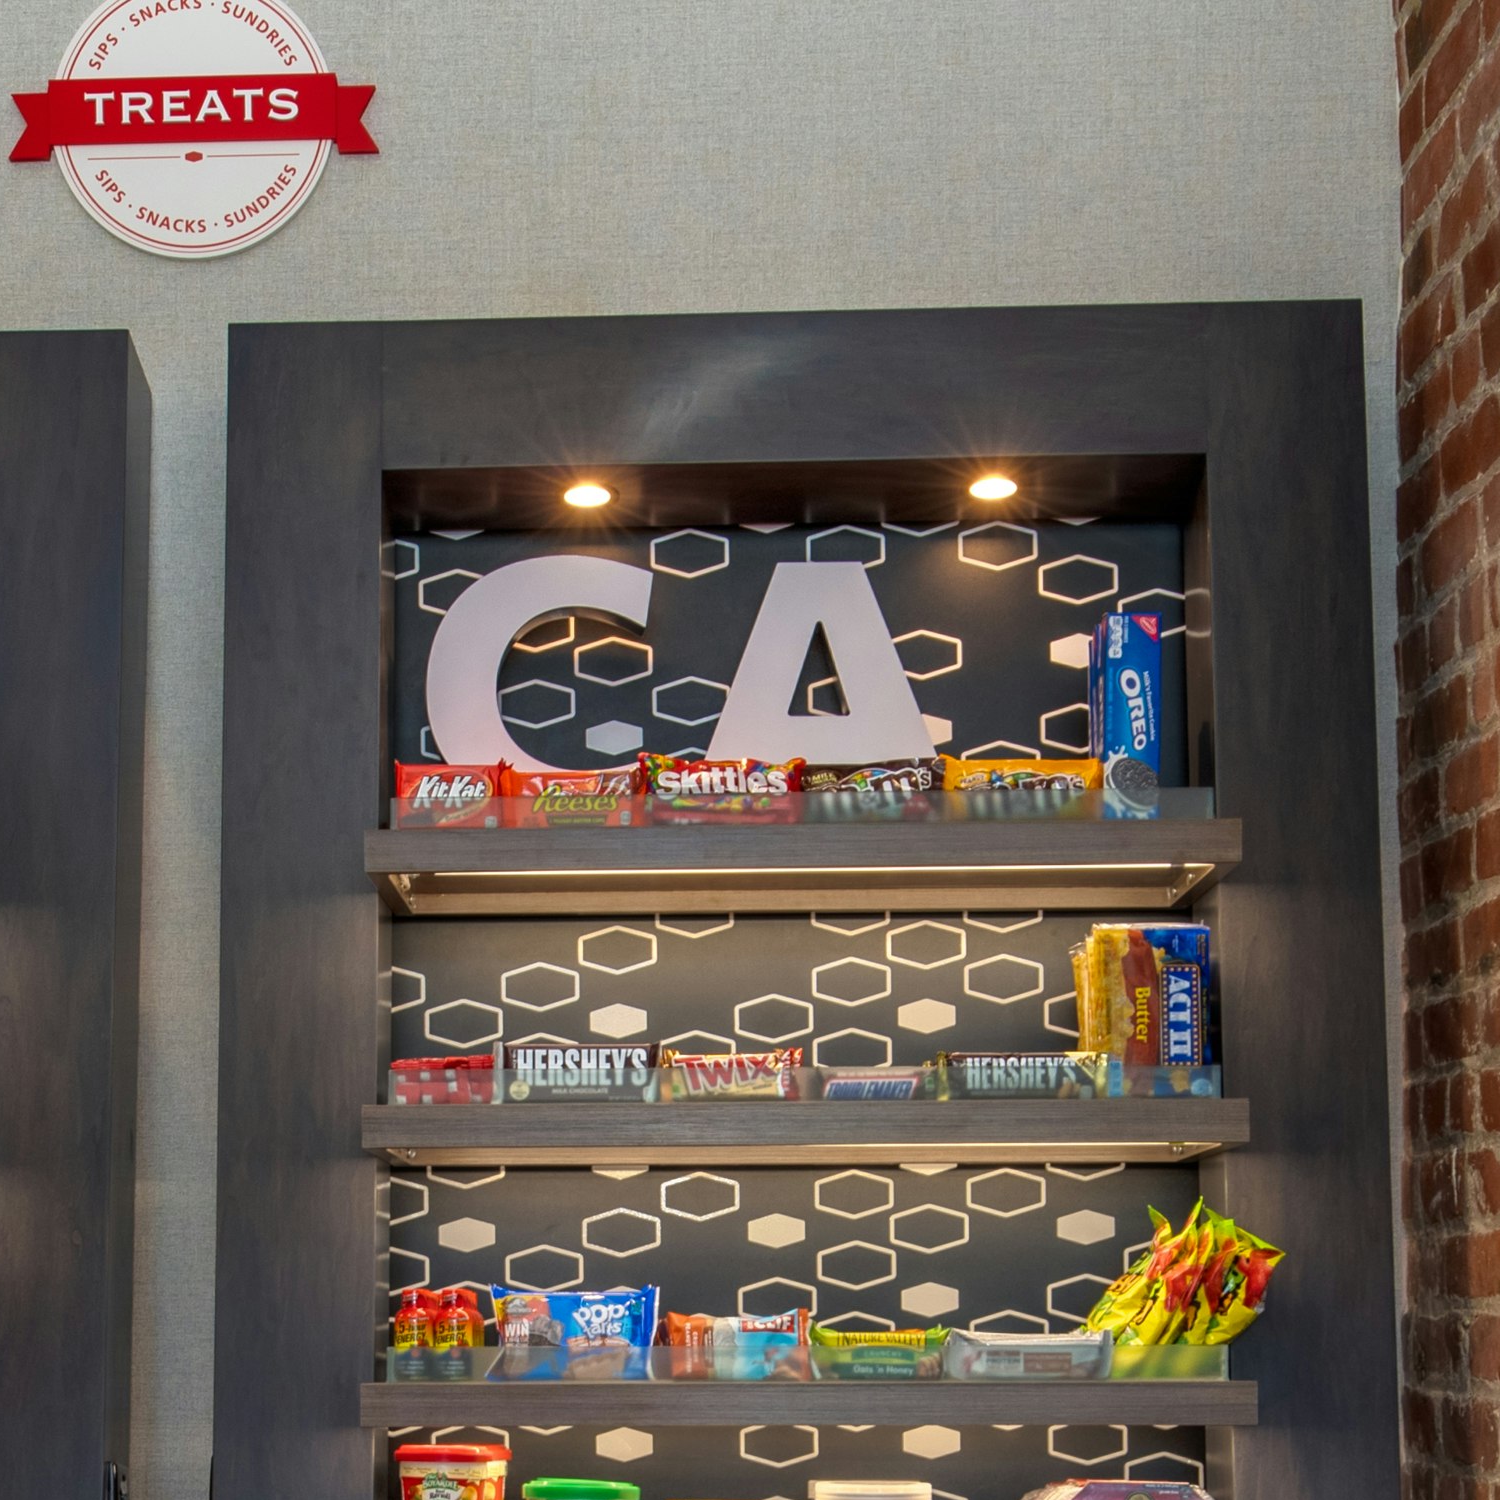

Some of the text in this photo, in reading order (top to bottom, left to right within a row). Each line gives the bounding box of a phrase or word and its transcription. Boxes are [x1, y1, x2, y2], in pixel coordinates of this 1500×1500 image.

[89, 0, 298, 70] SIPS SNACKS SUNDRIES
[84, 87, 299, 125] TREATS
[95, 164, 297, 233] SIPS SNACKS SUNDRIES
[1120, 668, 1147, 751] OREO
[1145, 691, 1154, 718] Favorite
[1148, 718, 1156, 741] Cookie
[1135, 987, 1152, 1044] Butter
[1169, 975, 1192, 1024] ACT
[517, 1048, 647, 1087] HERSHEY'S
[674, 1056, 776, 1094] TWIX
[967, 1057, 1077, 1089] HERSHEY'S
[396, 1333, 426, 1345] ENERGY
[436, 1333, 466, 1345] ENERGY
[505, 1322, 529, 1337] WIN
[841, 1333, 923, 1346] NATURE VALLEY
[886, 1364, 913, 1377] Honey
